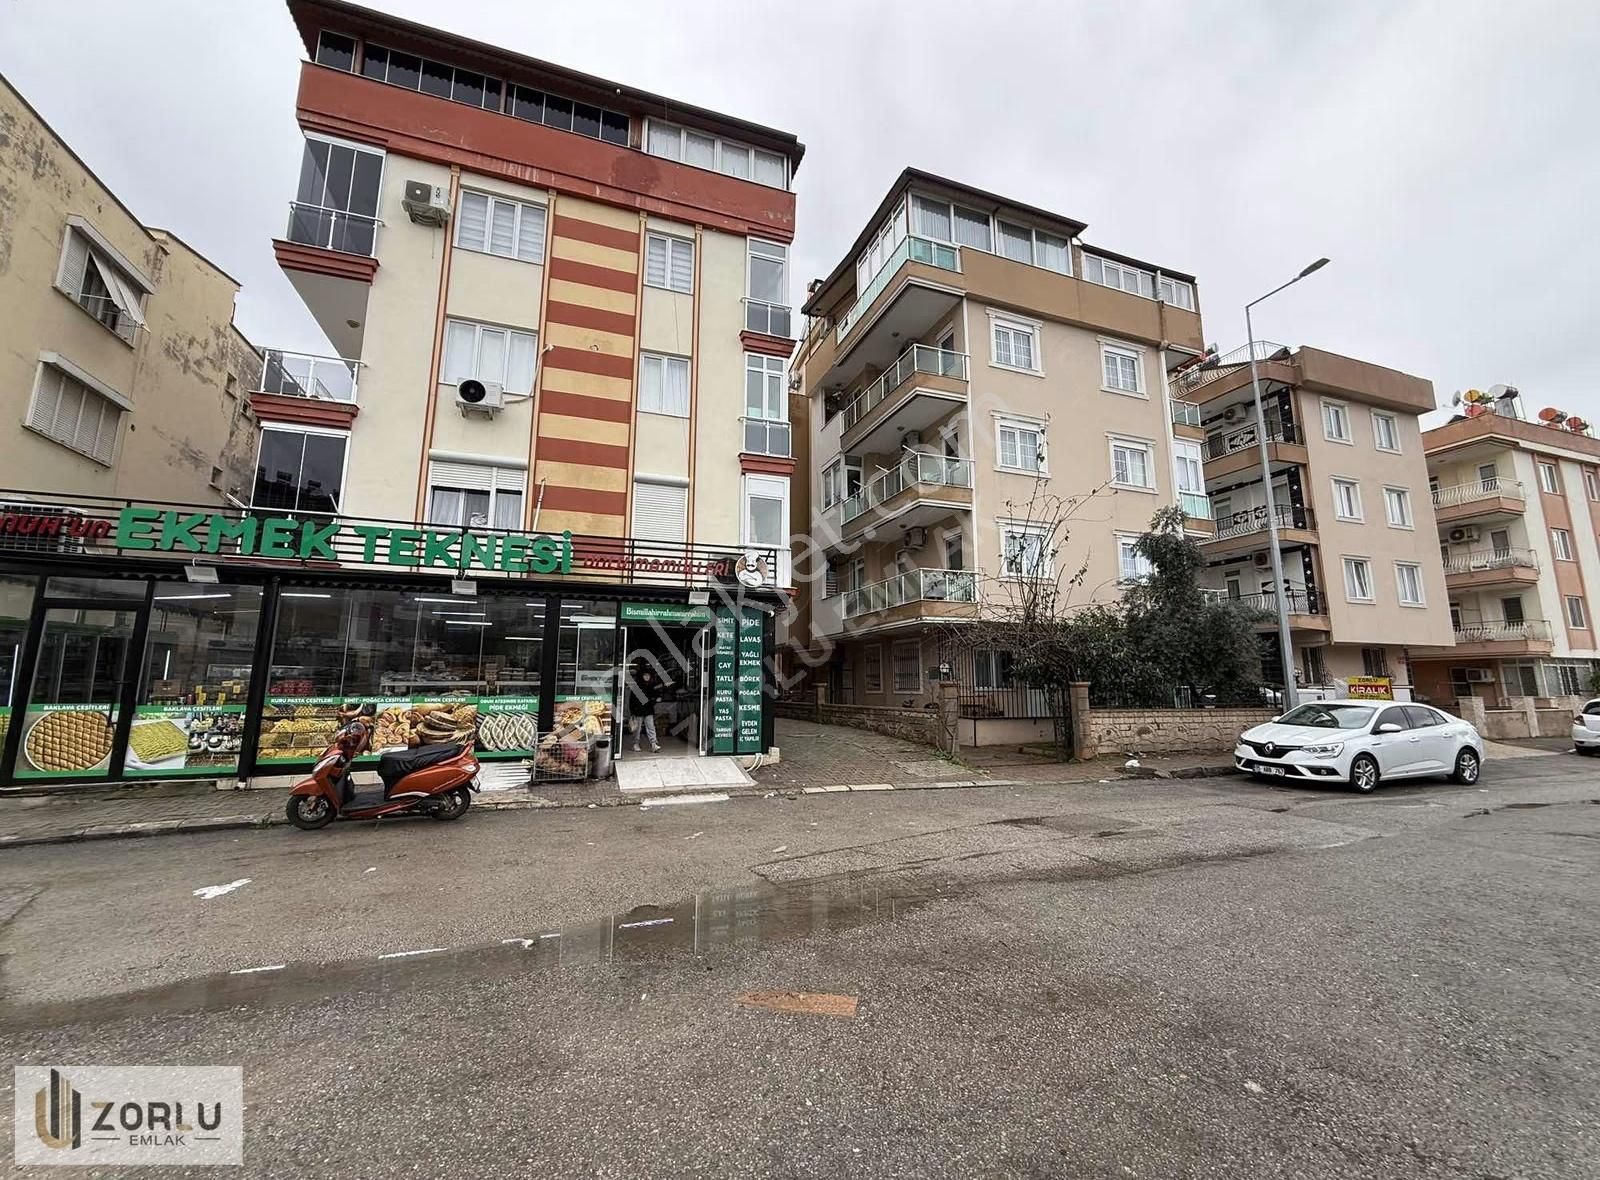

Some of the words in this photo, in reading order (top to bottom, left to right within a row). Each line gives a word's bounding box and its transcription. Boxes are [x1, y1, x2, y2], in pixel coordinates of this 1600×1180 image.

[116, 508, 340, 560] EKMEK
[354, 530, 569, 575] TEKNESİ
[741, 617, 760, 626] PİDE
[717, 631, 734, 639] KETE
[740, 636, 761, 644] LAVAŞ
[741, 650, 759, 658] YAĞLI
